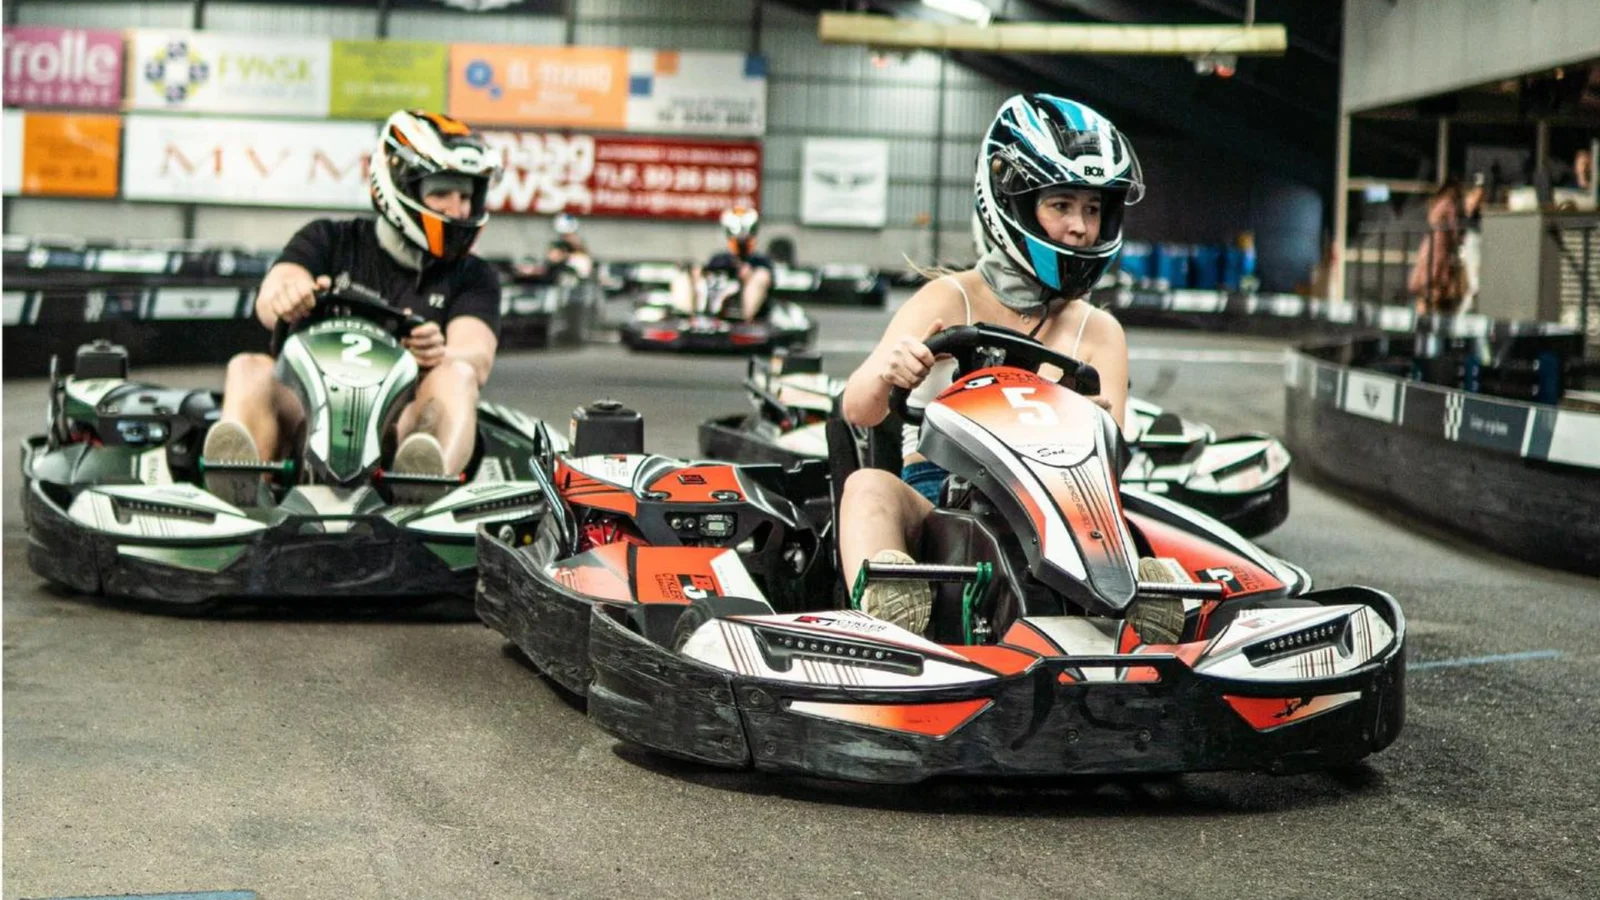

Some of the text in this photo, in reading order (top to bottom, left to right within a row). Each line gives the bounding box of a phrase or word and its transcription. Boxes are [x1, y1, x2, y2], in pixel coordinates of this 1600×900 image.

[160, 145, 371, 183] MVM
[1083, 165, 1105, 177] BOX
[341, 333, 373, 367] 2
[1001, 387, 1060, 425] 5
